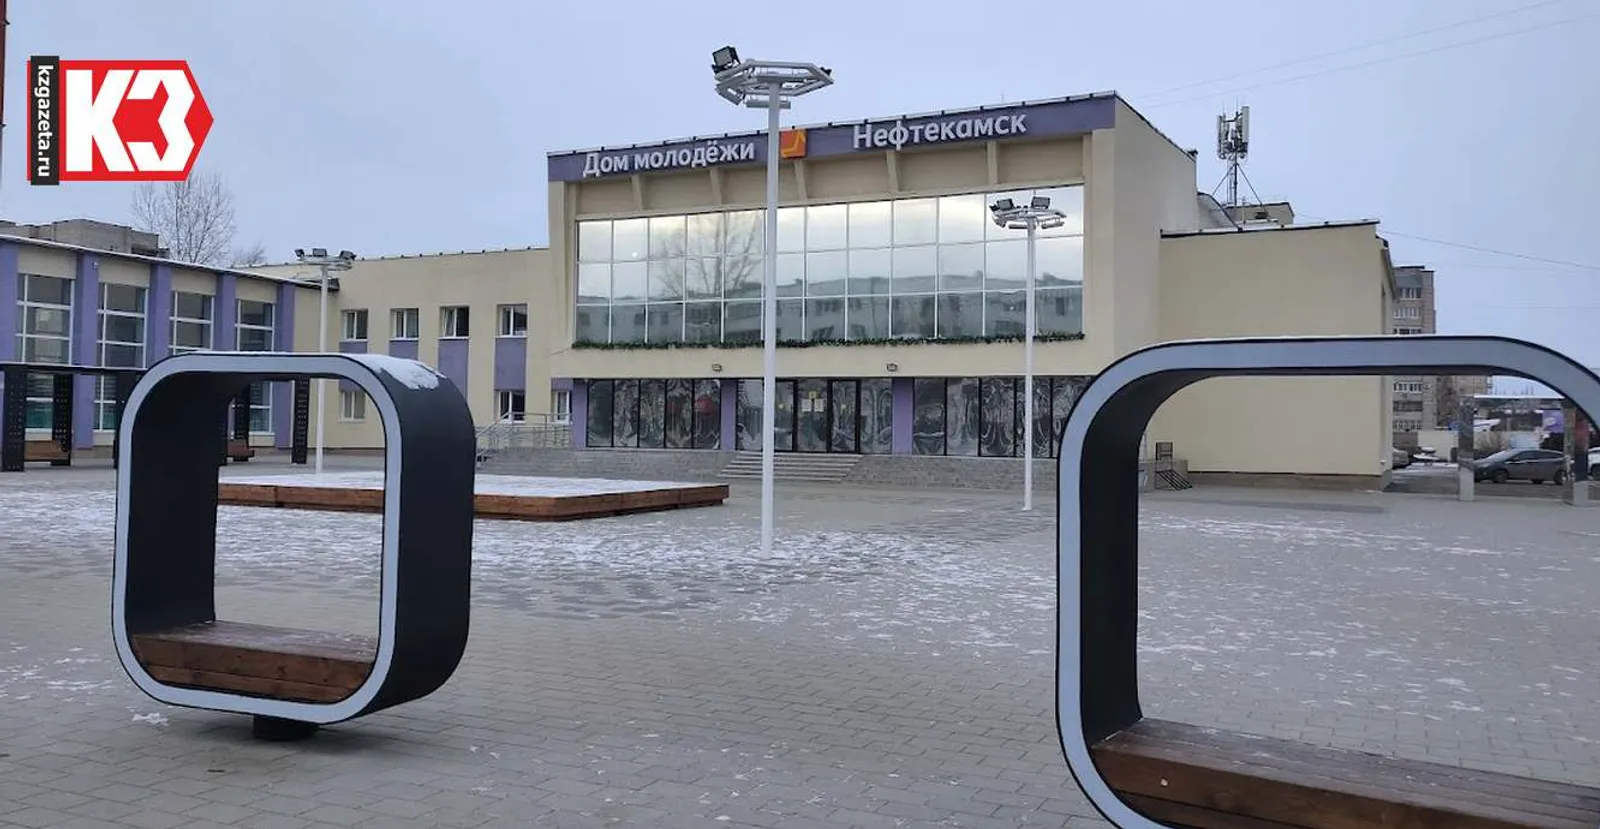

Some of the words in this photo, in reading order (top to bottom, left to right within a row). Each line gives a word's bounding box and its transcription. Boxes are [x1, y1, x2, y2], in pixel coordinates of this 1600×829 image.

[854, 113, 1027, 150] Нефтекамск
[583, 152, 629, 177] Дом
[634, 141, 755, 170] молодёжи
